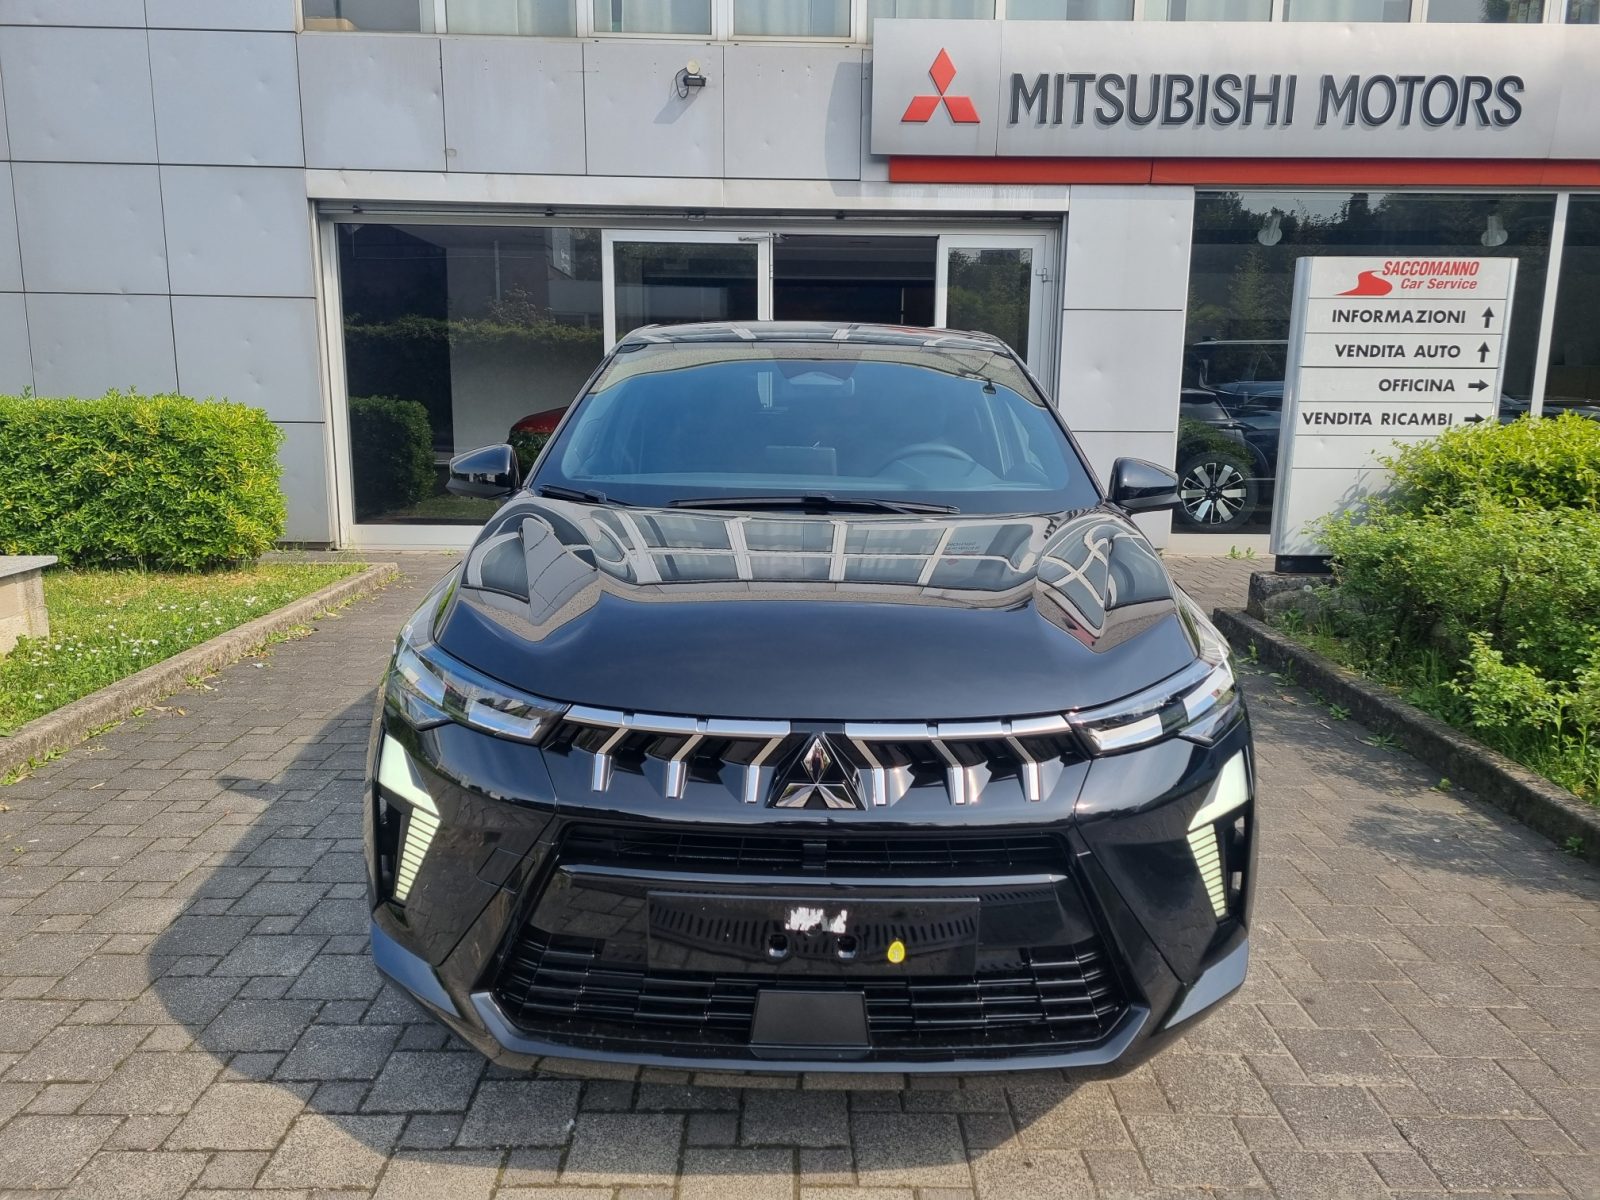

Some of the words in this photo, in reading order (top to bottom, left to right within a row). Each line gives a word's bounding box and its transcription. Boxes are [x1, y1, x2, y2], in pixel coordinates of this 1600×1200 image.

[1009, 72, 1298, 126] MITSUBISHI
[1319, 73, 1525, 127] MOTORS
[1382, 260, 1480, 277] SACCOMANNO
[1400, 278, 1425, 290] Car
[1427, 278, 1478, 290] Service
[1331, 309, 1467, 324] INFORMAZIONI
[1335, 343, 1406, 359] VENDITA
[1413, 344, 1461, 359] AUTO
[1378, 378, 1456, 393] OFFICINA
[1302, 411, 1373, 426] VENDITA
[1380, 412, 1453, 427] RICAMBI
